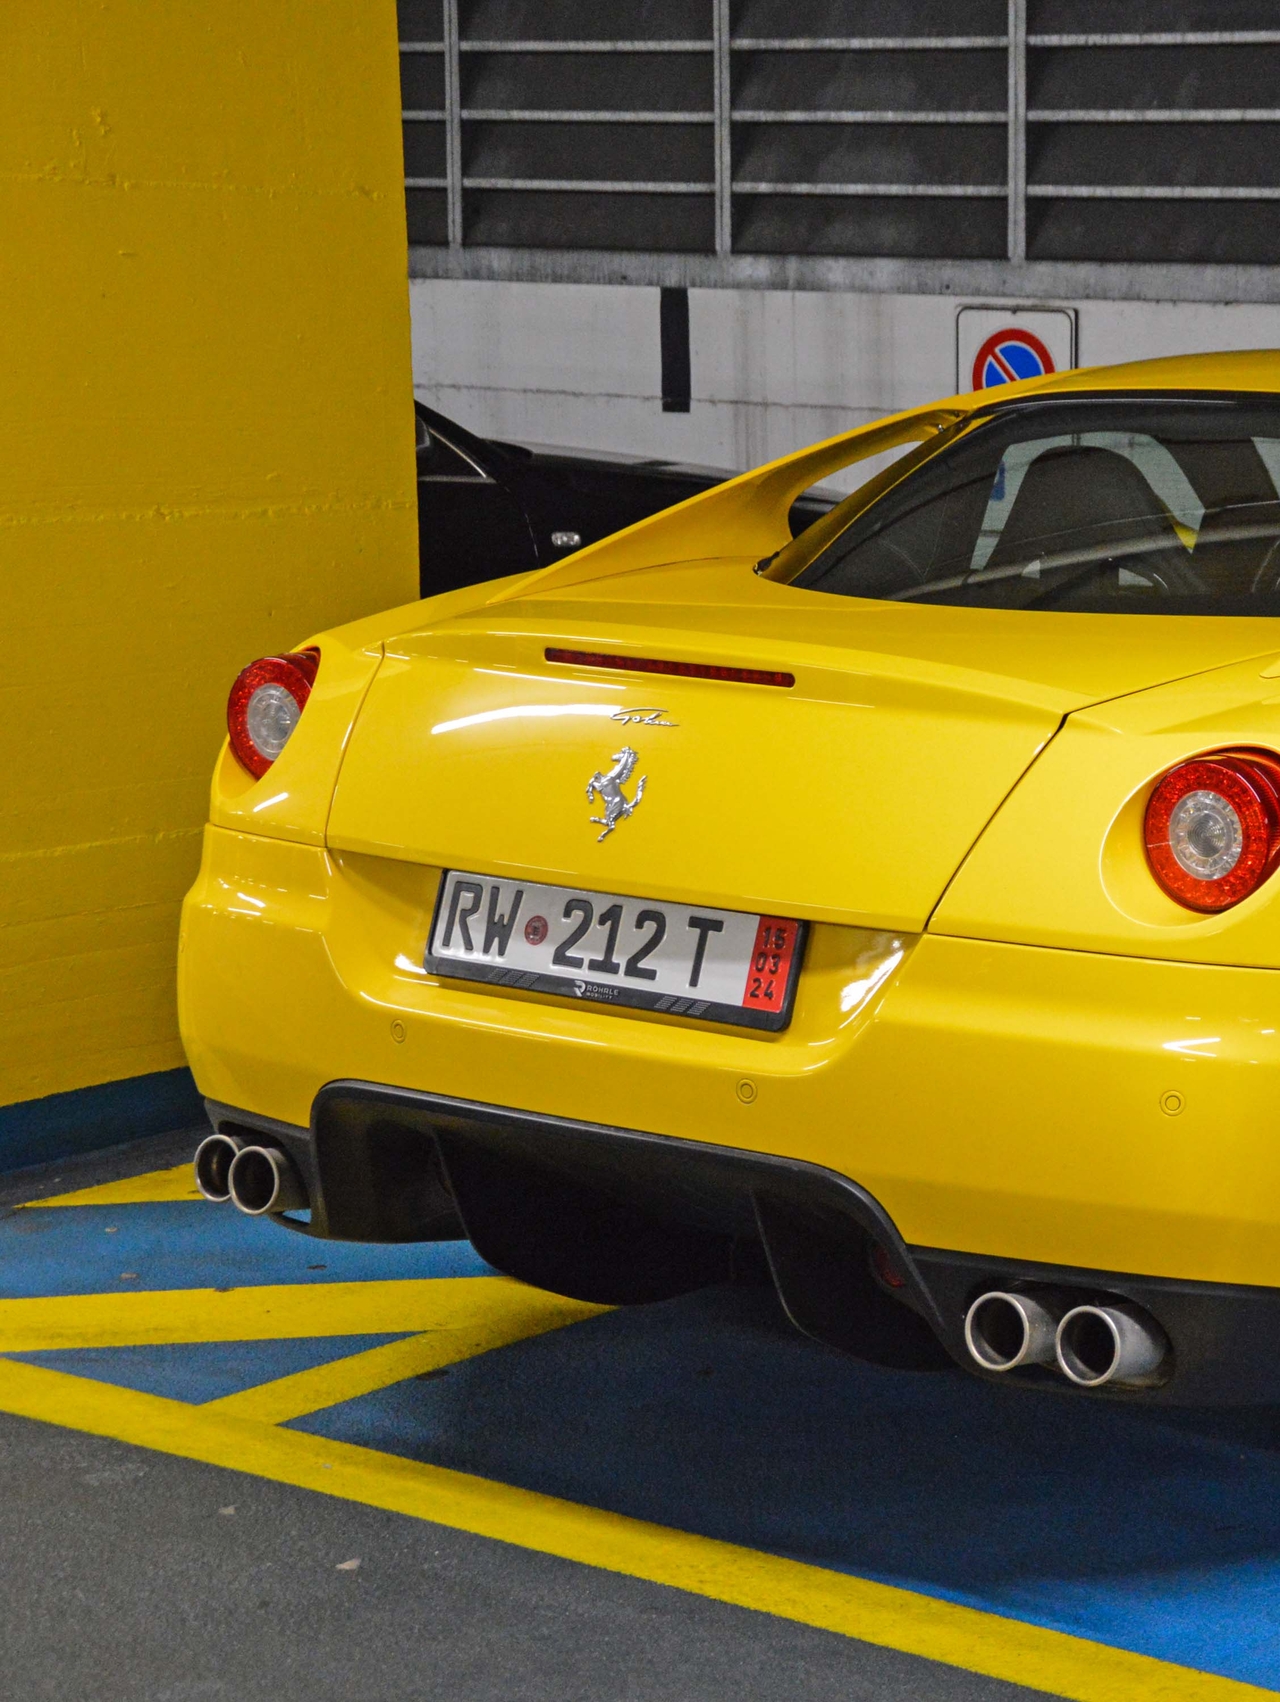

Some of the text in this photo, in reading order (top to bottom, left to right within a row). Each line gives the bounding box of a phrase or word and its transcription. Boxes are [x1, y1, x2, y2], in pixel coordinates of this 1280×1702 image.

[442, 881, 725, 988] RW 212 T
[763, 926, 787, 949] 15
[755, 952, 781, 974] 03
[749, 977, 774, 1000] 24
